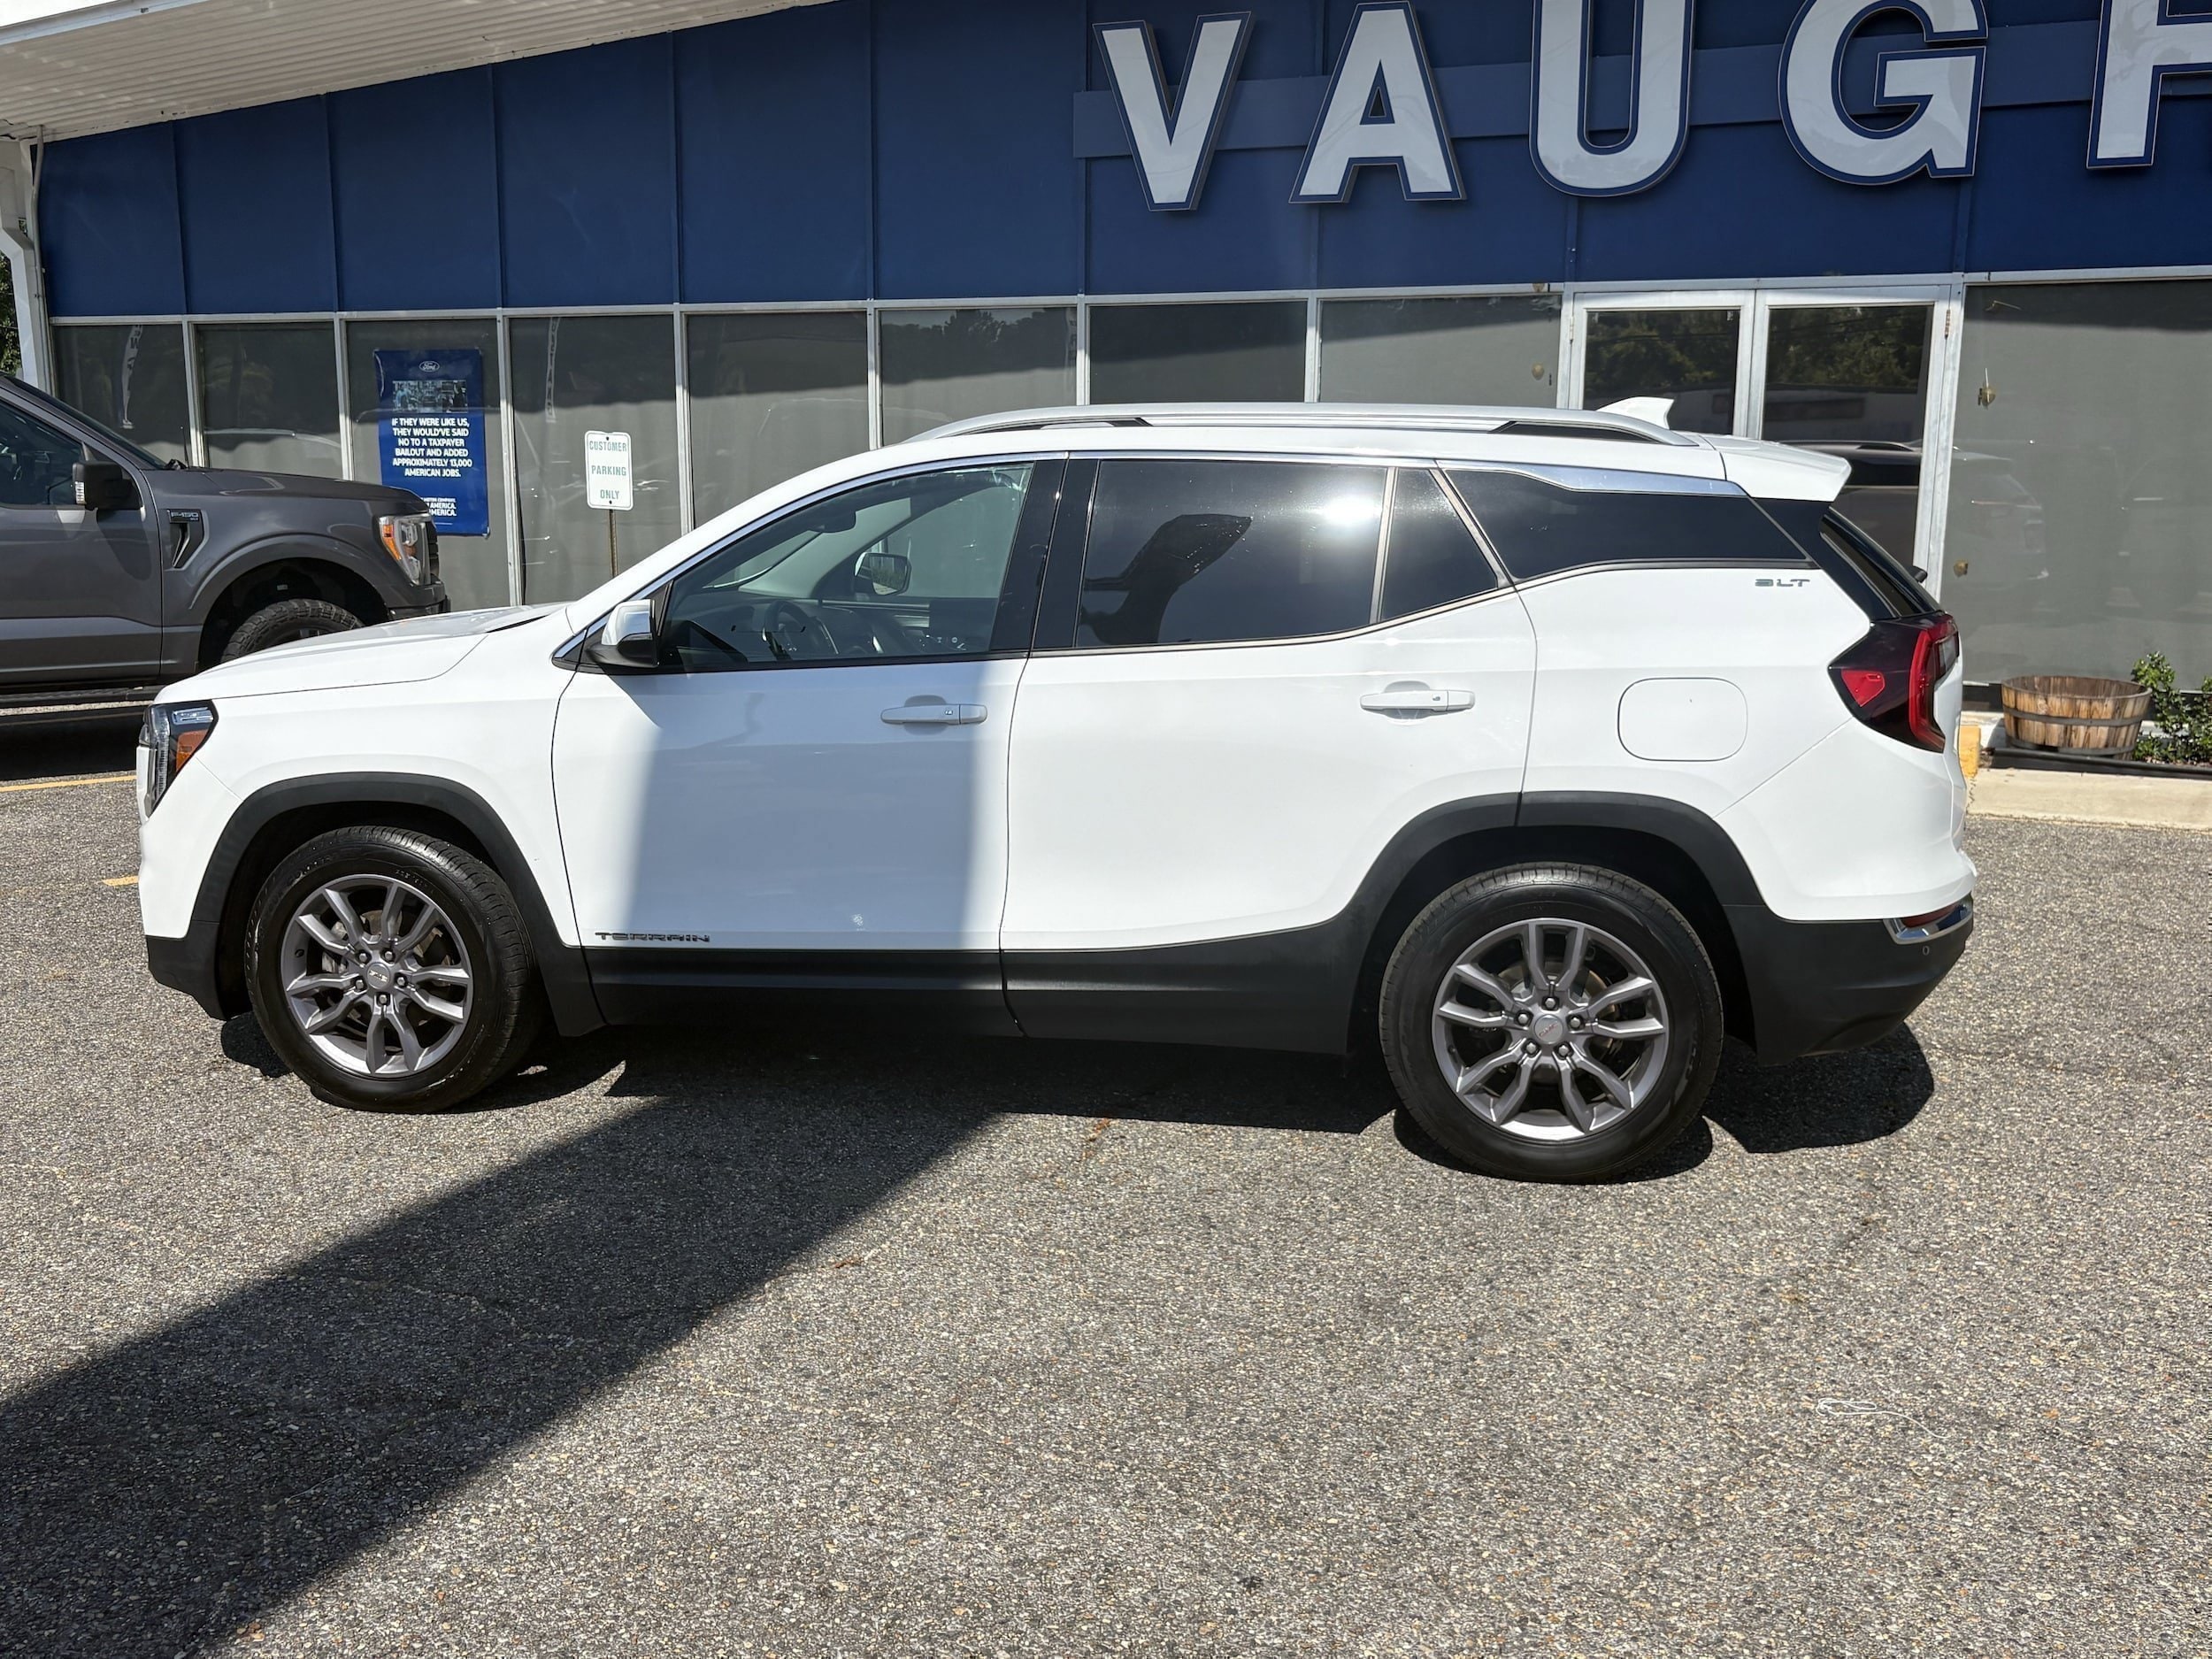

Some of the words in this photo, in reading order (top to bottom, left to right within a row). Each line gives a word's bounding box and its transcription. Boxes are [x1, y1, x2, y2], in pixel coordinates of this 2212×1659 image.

[391, 418, 398, 426] IF
[399, 418, 418, 426] THEY
[419, 418, 440, 426] WERE
[441, 418, 456, 426] LIKE
[457, 418, 470, 427] US,
[393, 427, 411, 436] THEY
[412, 427, 450, 437] WOULD'VE
[451, 428, 470, 437] SAID
[411, 438, 421, 447] TO
[428, 438, 465, 447] TAXPAYER
[589, 441, 626, 451] CUSTOMER
[395, 448, 426, 457] BAILOUT
[426, 448, 442, 457] AND
[443, 449, 469, 457] ADDED
[392, 457, 449, 467] APPROXIMATELY
[449, 458, 472, 468] 13,000
[404, 468, 442, 477] AMERICAN
[442, 469, 462, 478] JOBS.
[591, 465, 626, 476] PARKING
[600, 489, 620, 500] ONLY
[595, 932, 710, 942] TERRAIN
